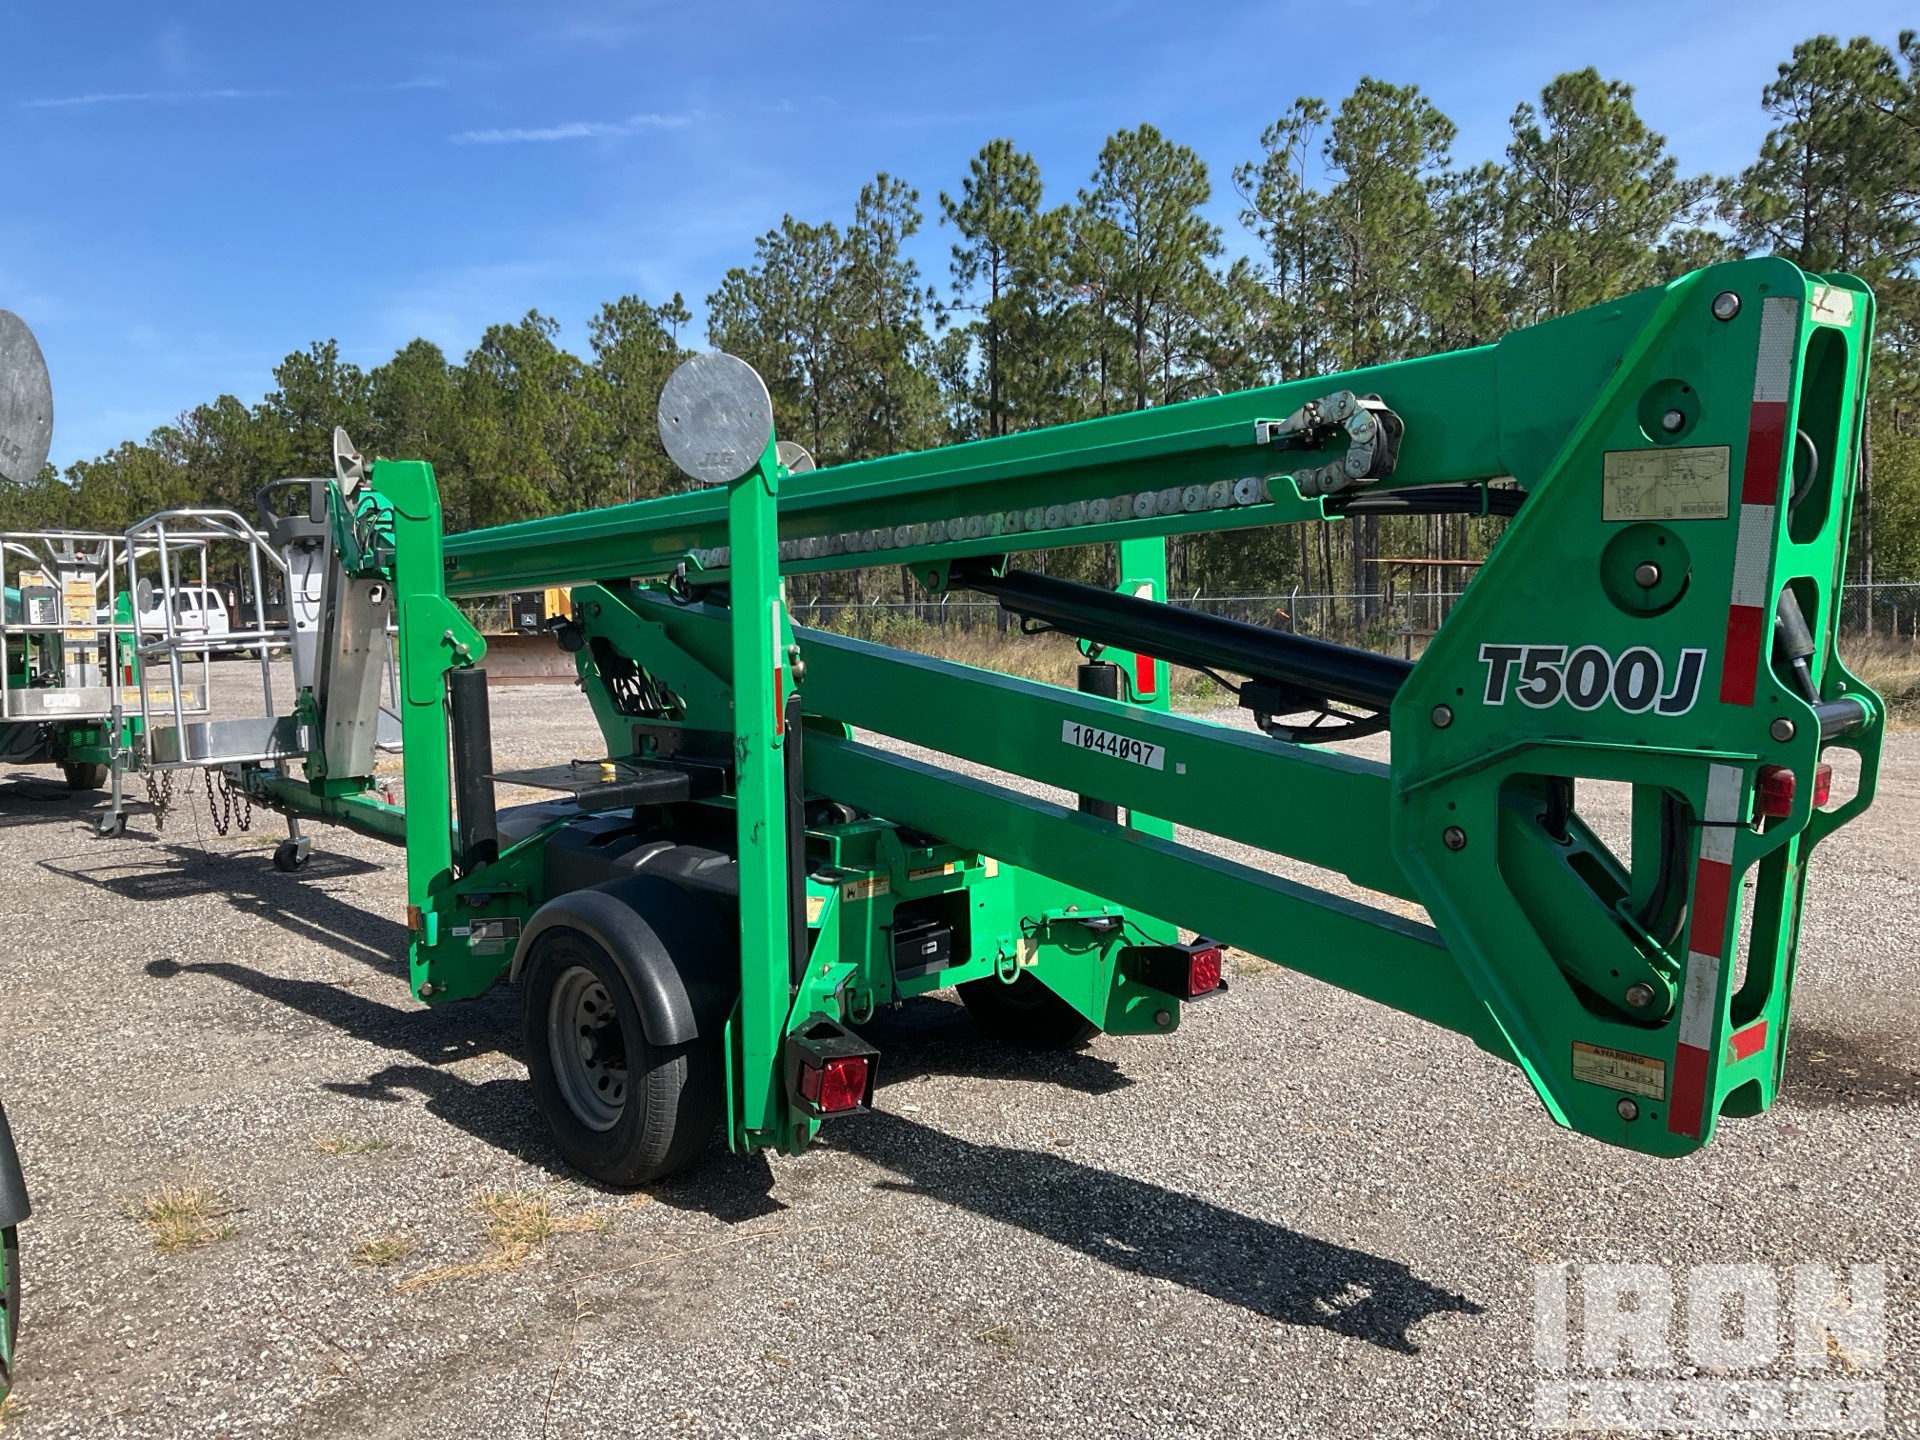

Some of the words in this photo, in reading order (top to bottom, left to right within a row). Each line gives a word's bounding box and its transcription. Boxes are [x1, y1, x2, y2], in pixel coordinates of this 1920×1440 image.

[698, 452, 735, 469] JLG
[1478, 643, 1708, 717] T500J
[1073, 725, 1155, 766] 1044097
[1601, 1049, 1645, 1065] WARNING
